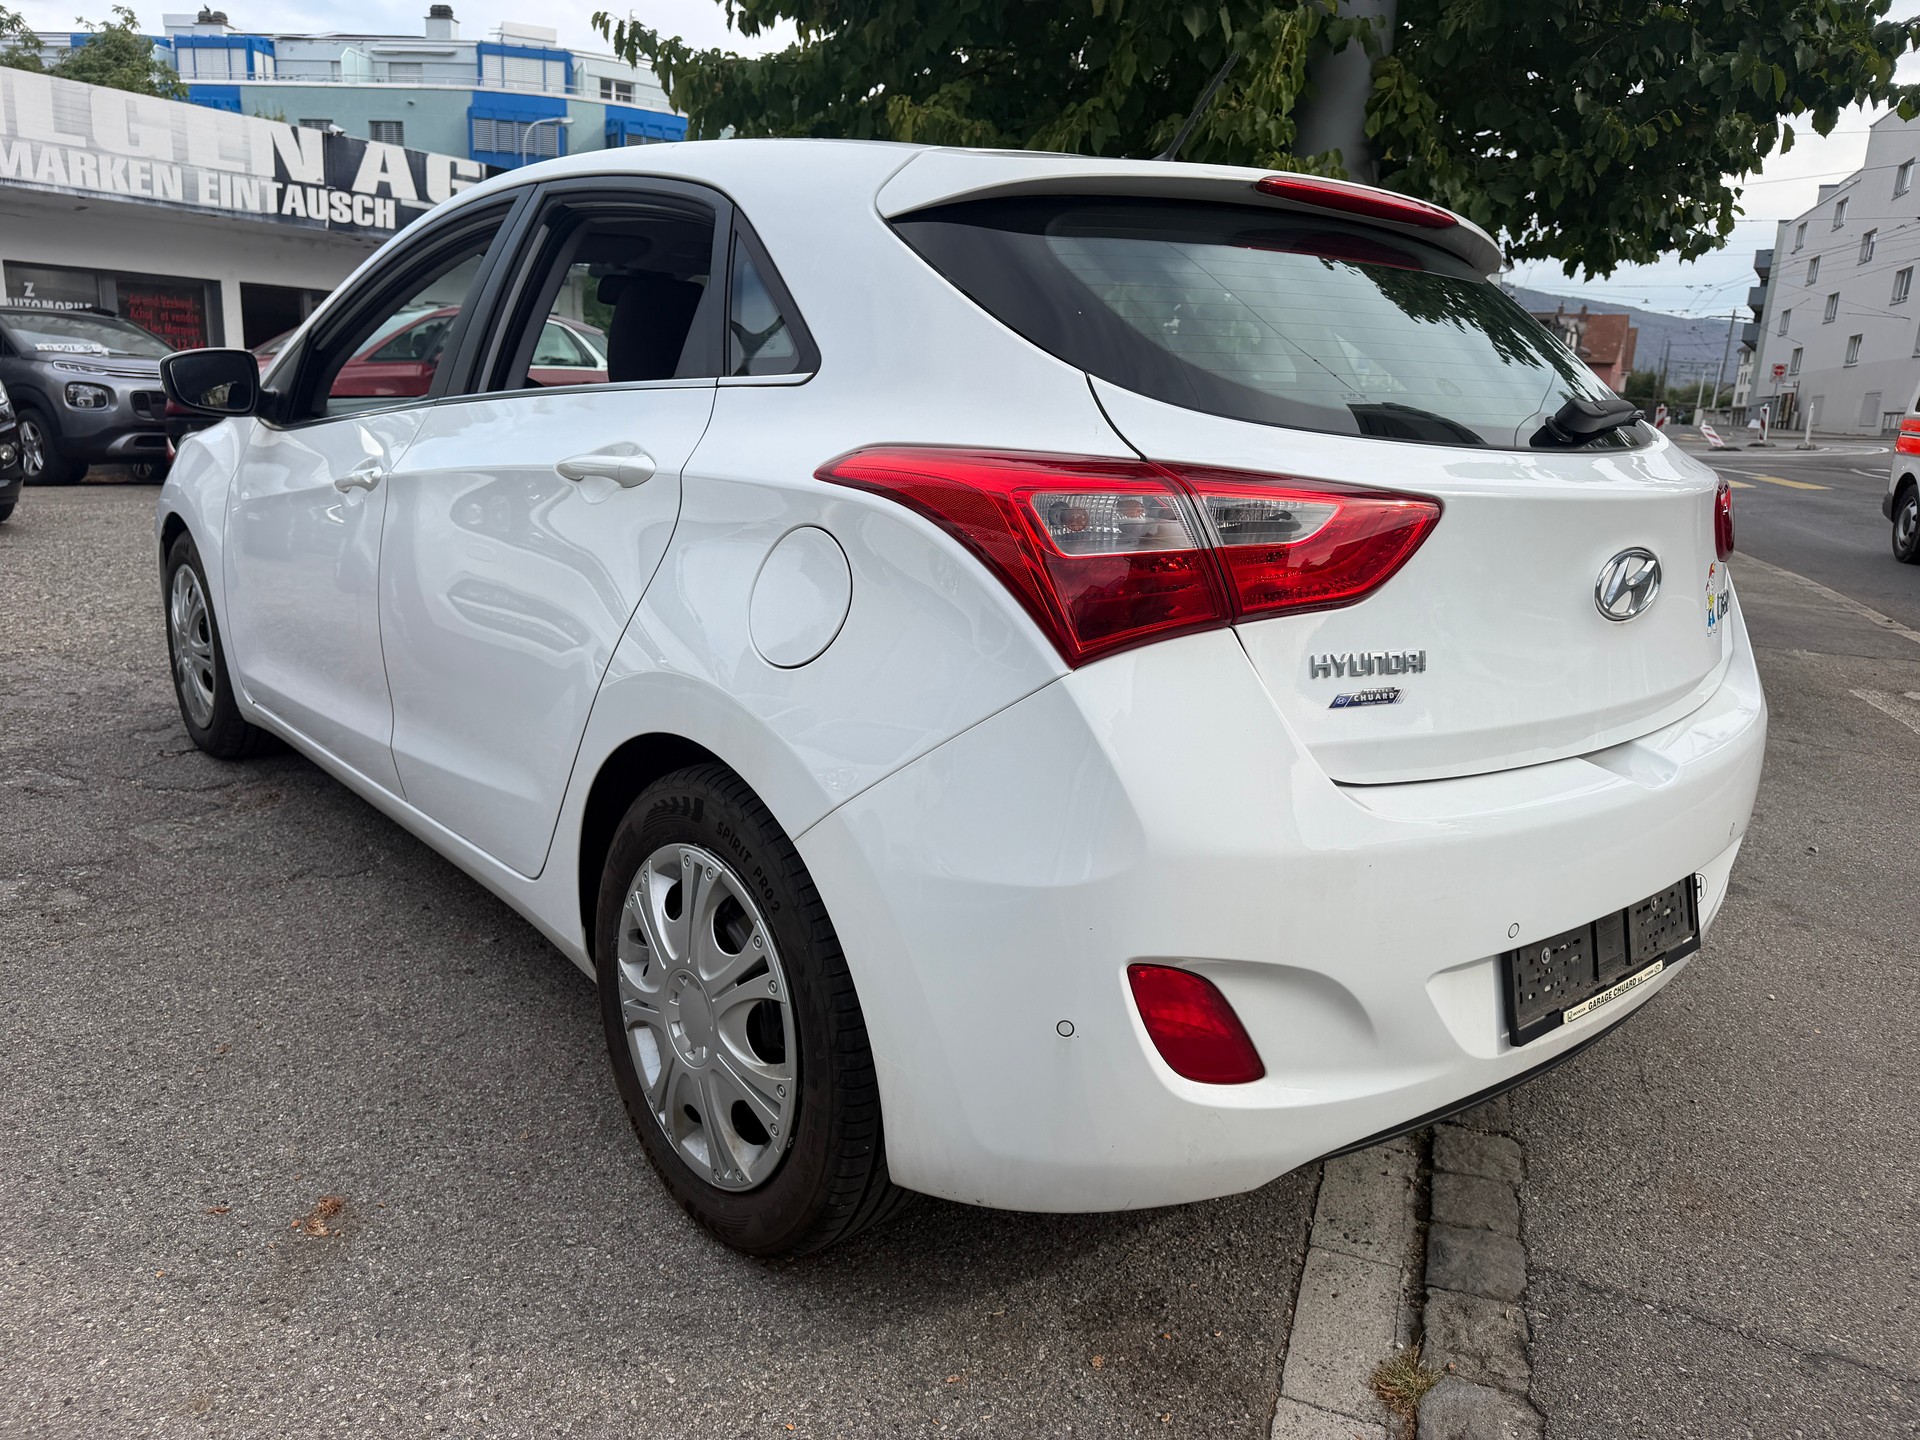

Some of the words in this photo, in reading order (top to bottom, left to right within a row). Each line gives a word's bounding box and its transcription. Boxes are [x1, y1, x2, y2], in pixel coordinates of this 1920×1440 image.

[0, 72, 325, 184] LGEN
[351, 140, 481, 205] AG
[0, 137, 183, 200] MARKEN
[198, 168, 396, 230] EINTAUSCH
[23, 281, 36, 298] Z
[1310, 650, 1427, 679] HYUNDAI
[1354, 692, 1396, 702] CHUARD
[716, 821, 752, 863] SPIRIT
[1588, 990, 1613, 1010] GARAGE
[1613, 977, 1637, 996] CHUARD
